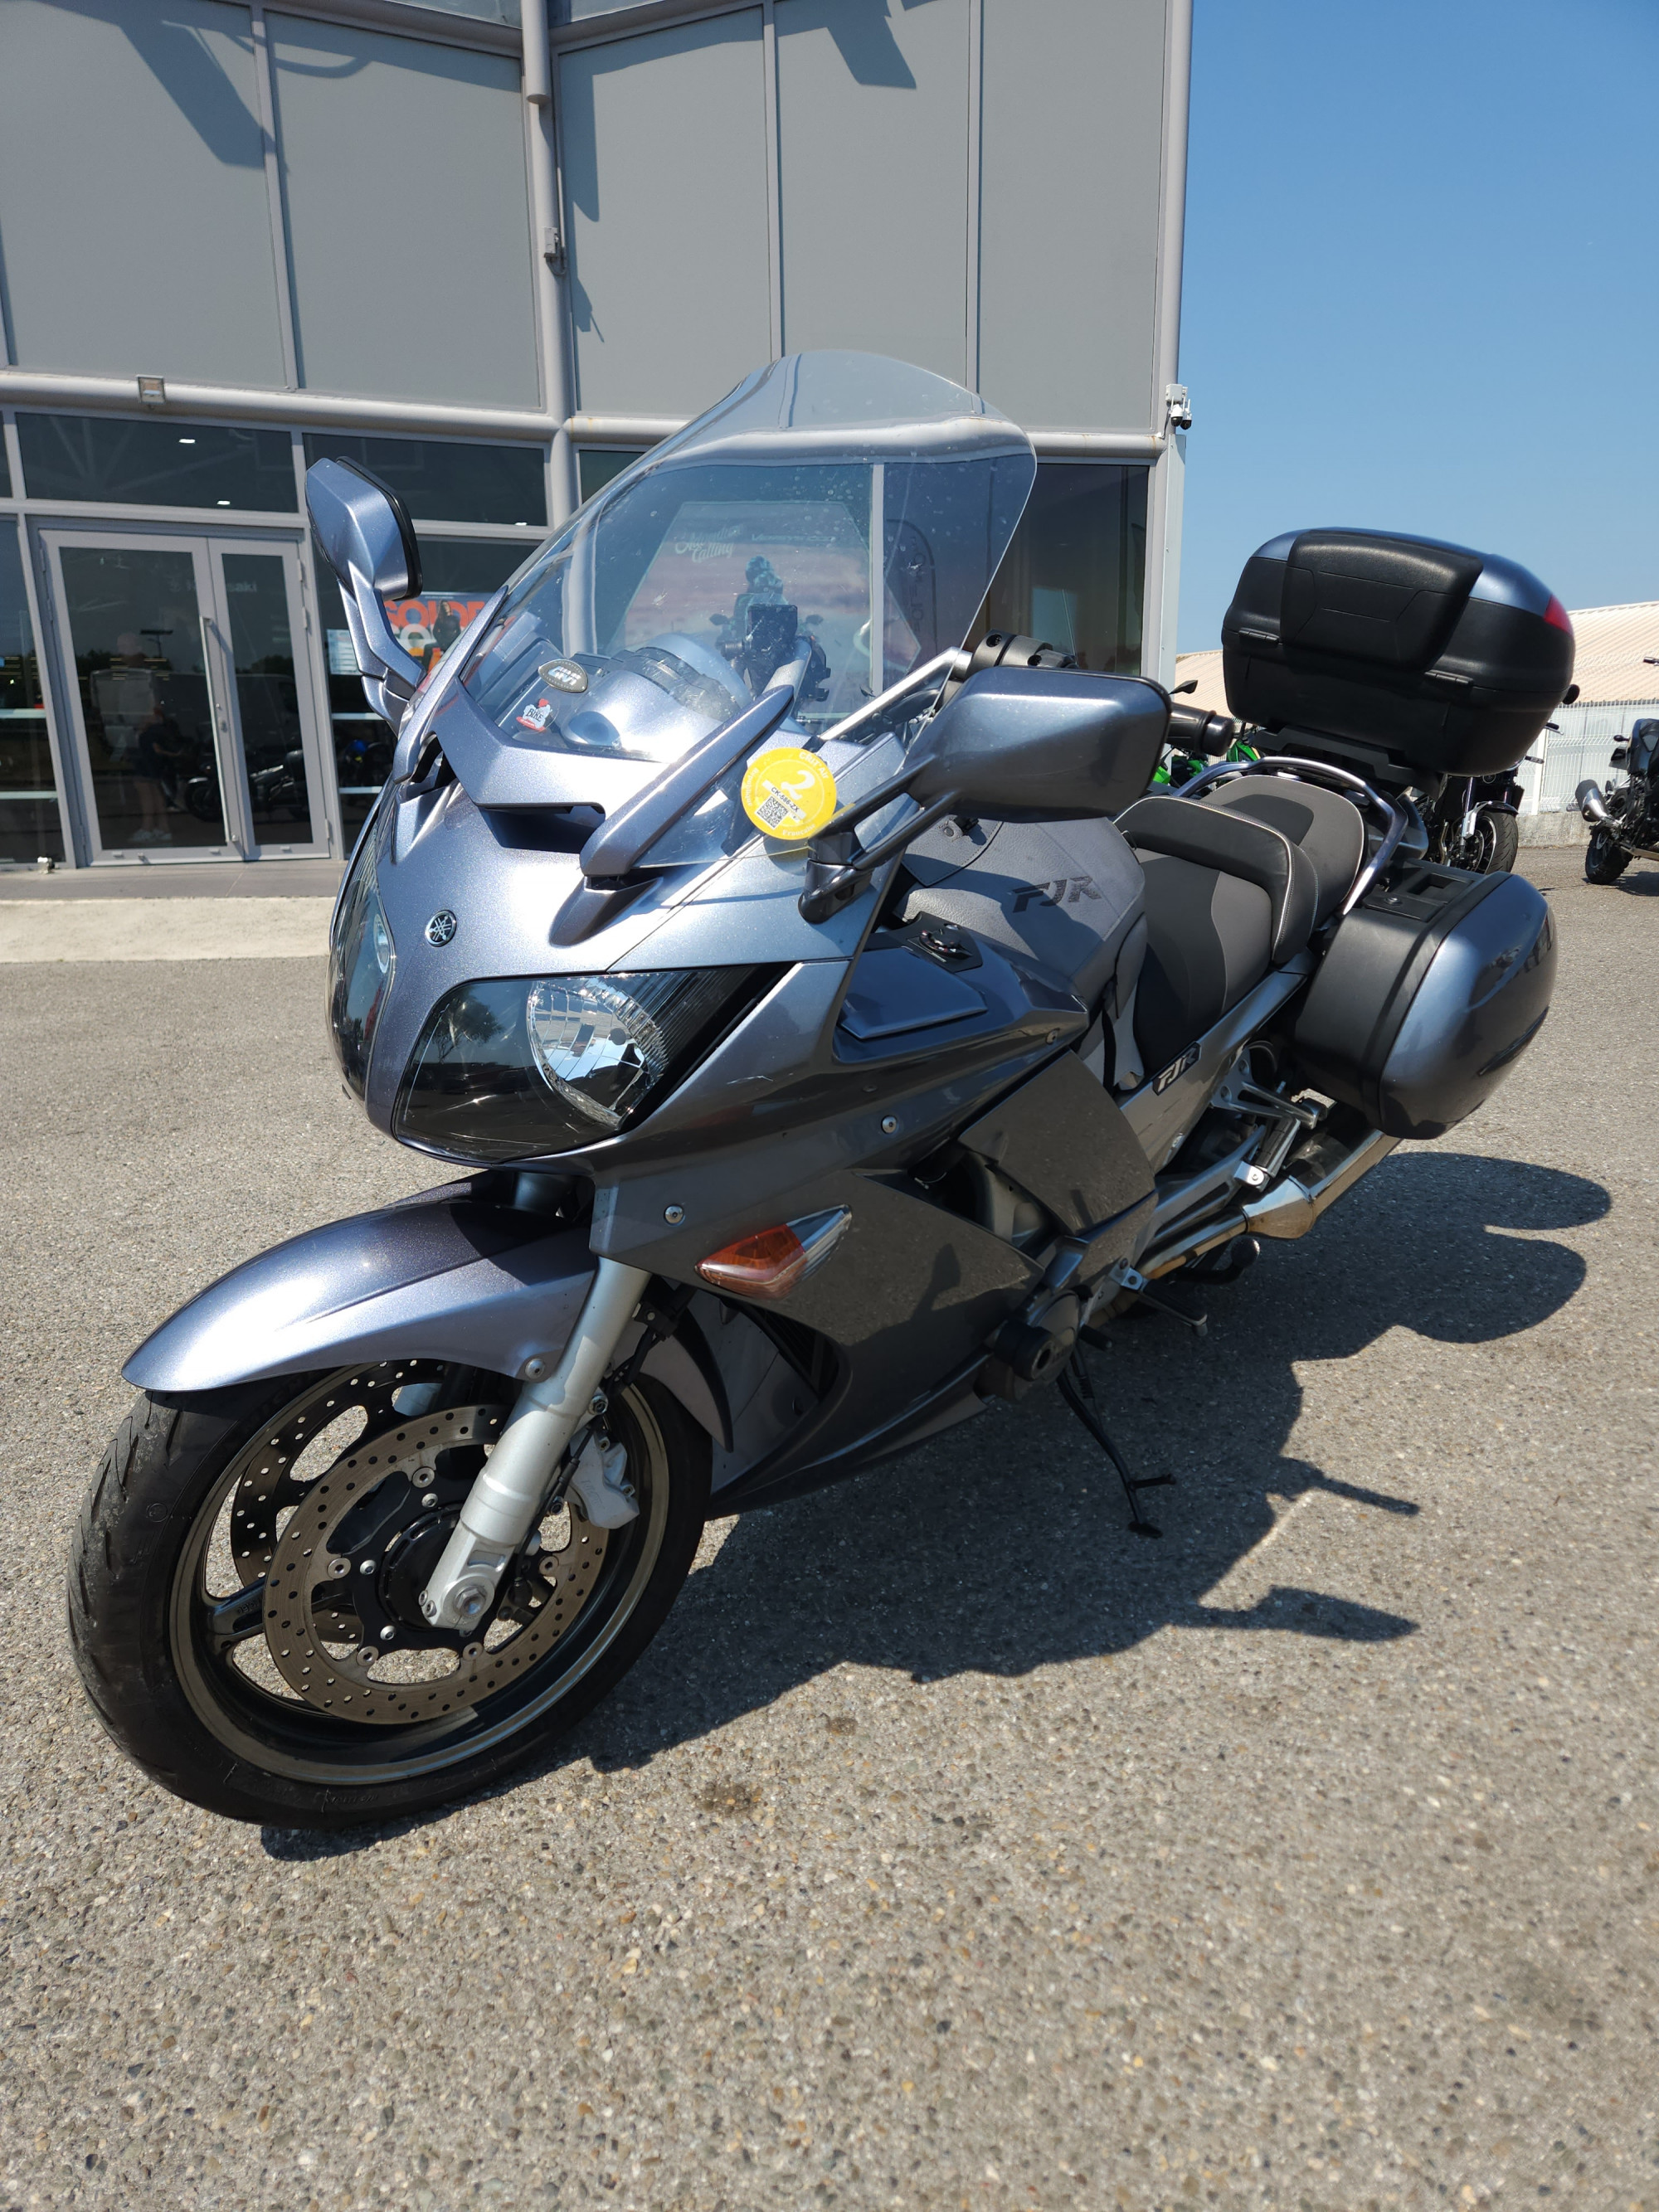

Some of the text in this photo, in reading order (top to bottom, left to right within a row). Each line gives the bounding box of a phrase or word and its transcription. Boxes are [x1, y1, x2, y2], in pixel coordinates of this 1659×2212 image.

[384, 600, 486, 629] SOLDE
[525, 708, 544, 722] BIKE
[781, 770, 815, 800] 2
[771, 786, 800, 814] CK-586-ZX
[1012, 875, 1102, 913] FJR
[1157, 1047, 1197, 1092] FJR
